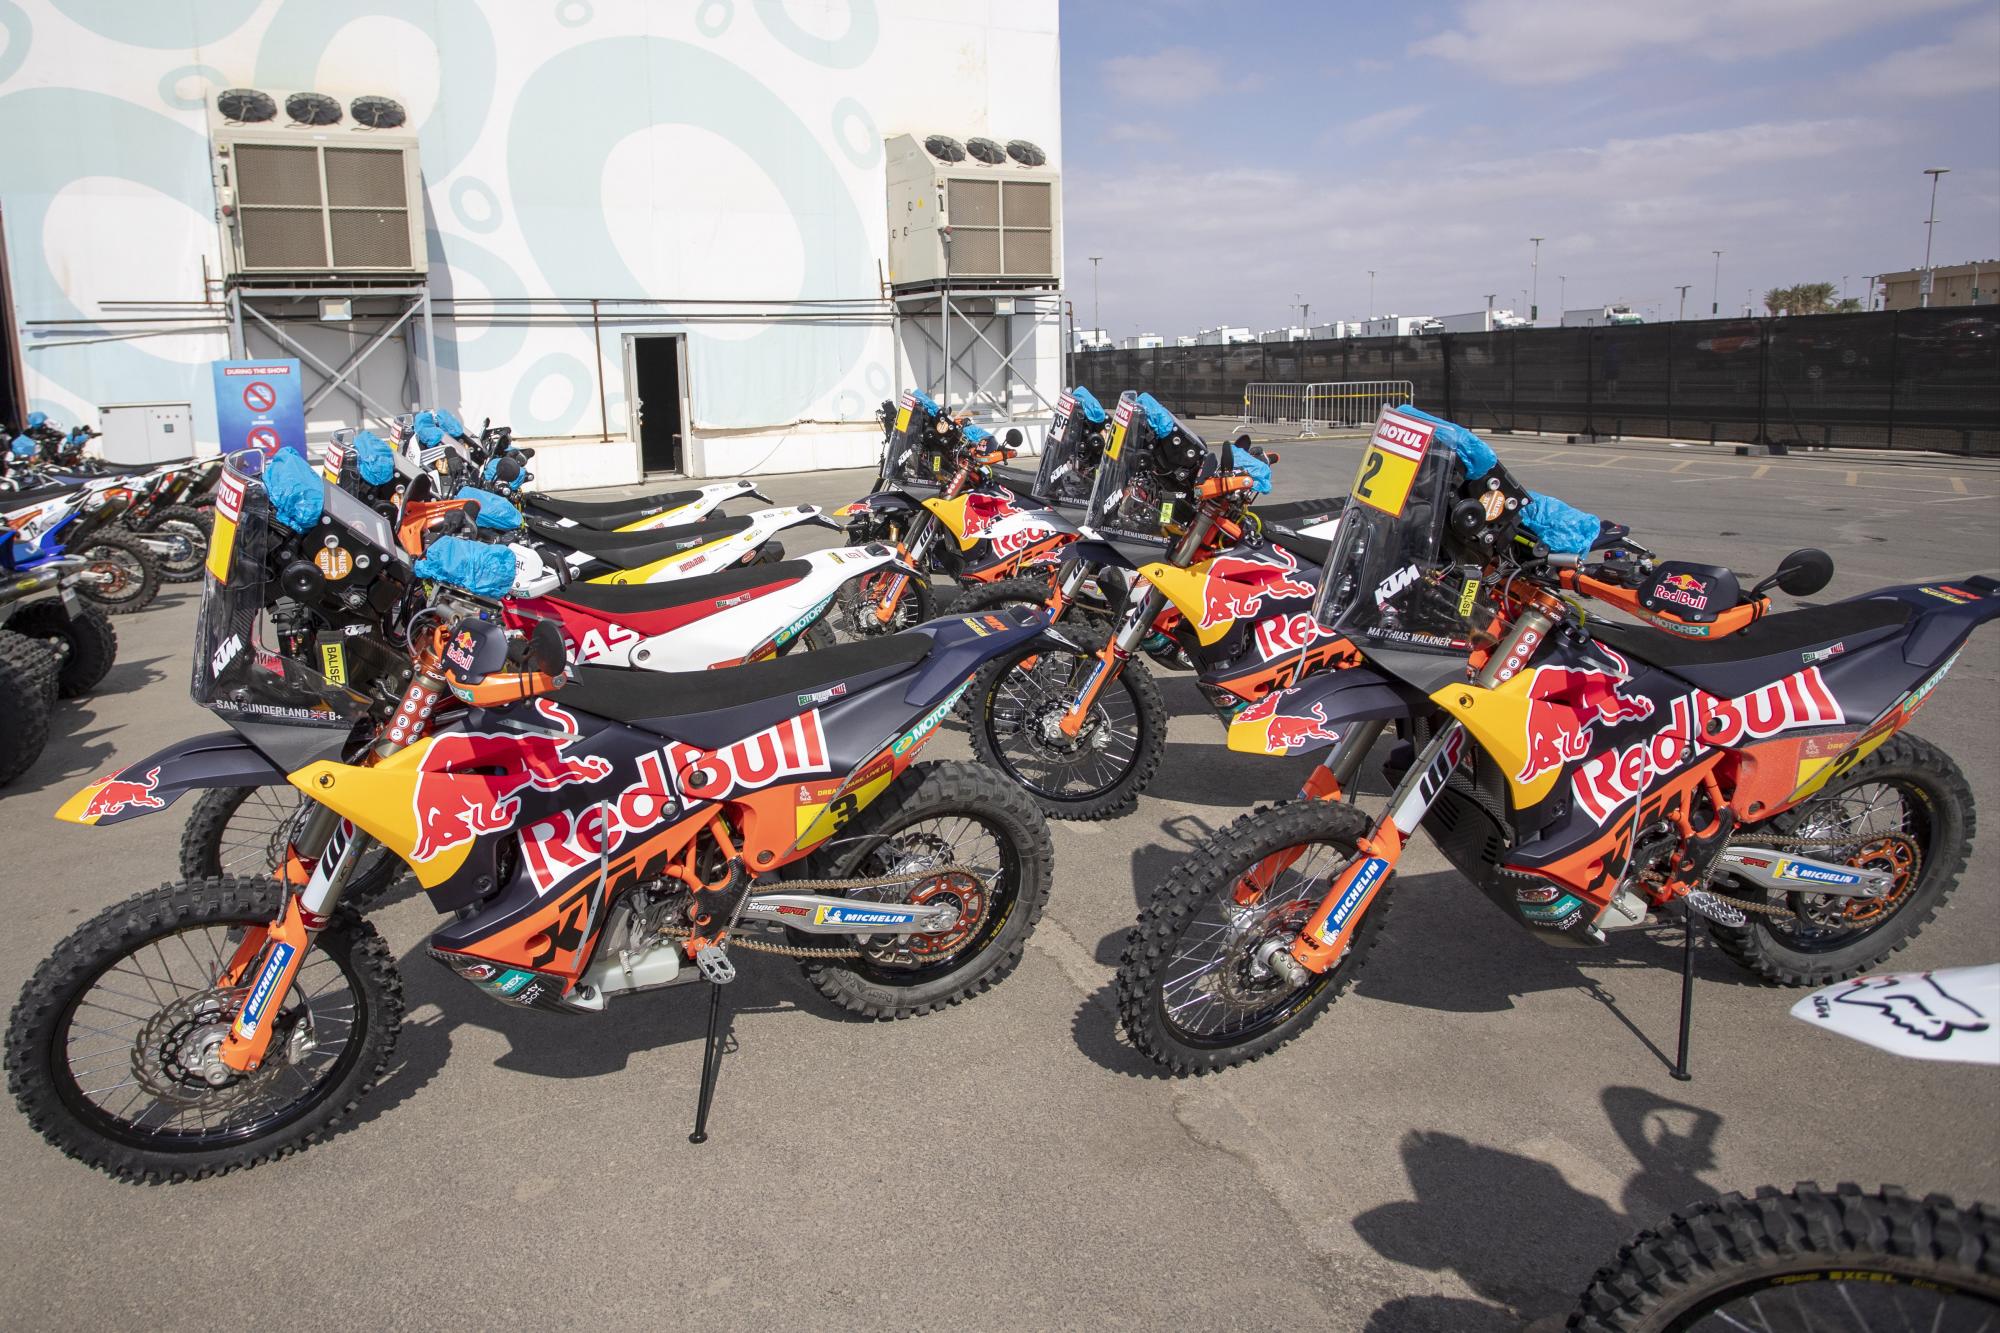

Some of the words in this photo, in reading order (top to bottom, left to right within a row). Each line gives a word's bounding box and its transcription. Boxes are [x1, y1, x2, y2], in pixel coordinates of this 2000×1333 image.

[226, 367, 253, 376] DURING
[253, 367, 267, 375] THE
[267, 366, 288, 375] SHOW
[1378, 422, 1423, 449] MOTUL
[1358, 451, 1384, 499] 2
[1103, 488, 1124, 515] KTM
[1374, 563, 1421, 606] KTM
[1460, 581, 1478, 616] BALISE
[345, 624, 373, 637] KTM
[1366, 626, 1411, 642] MATTHIAS
[1410, 634, 1453, 648] WALKNER
[1650, 615, 1706, 636] MOTOREX
[211, 633, 243, 680] KTM
[326, 646, 342, 686] BALISE
[216, 699, 239, 712] SAM
[241, 702, 309, 719] SUNDERLAND
[328, 711, 344, 721] B+
[829, 792, 860, 832] 3
[1799, 869, 1854, 884] MICHELIN
[1333, 860, 1380, 925] MICHELIN
[844, 913, 907, 923] MICHELIN
[1301, 932, 1321, 951] KTM
[247, 946, 287, 1017] MICHELIN
[1828, 1271, 1899, 1284] EXCEL
